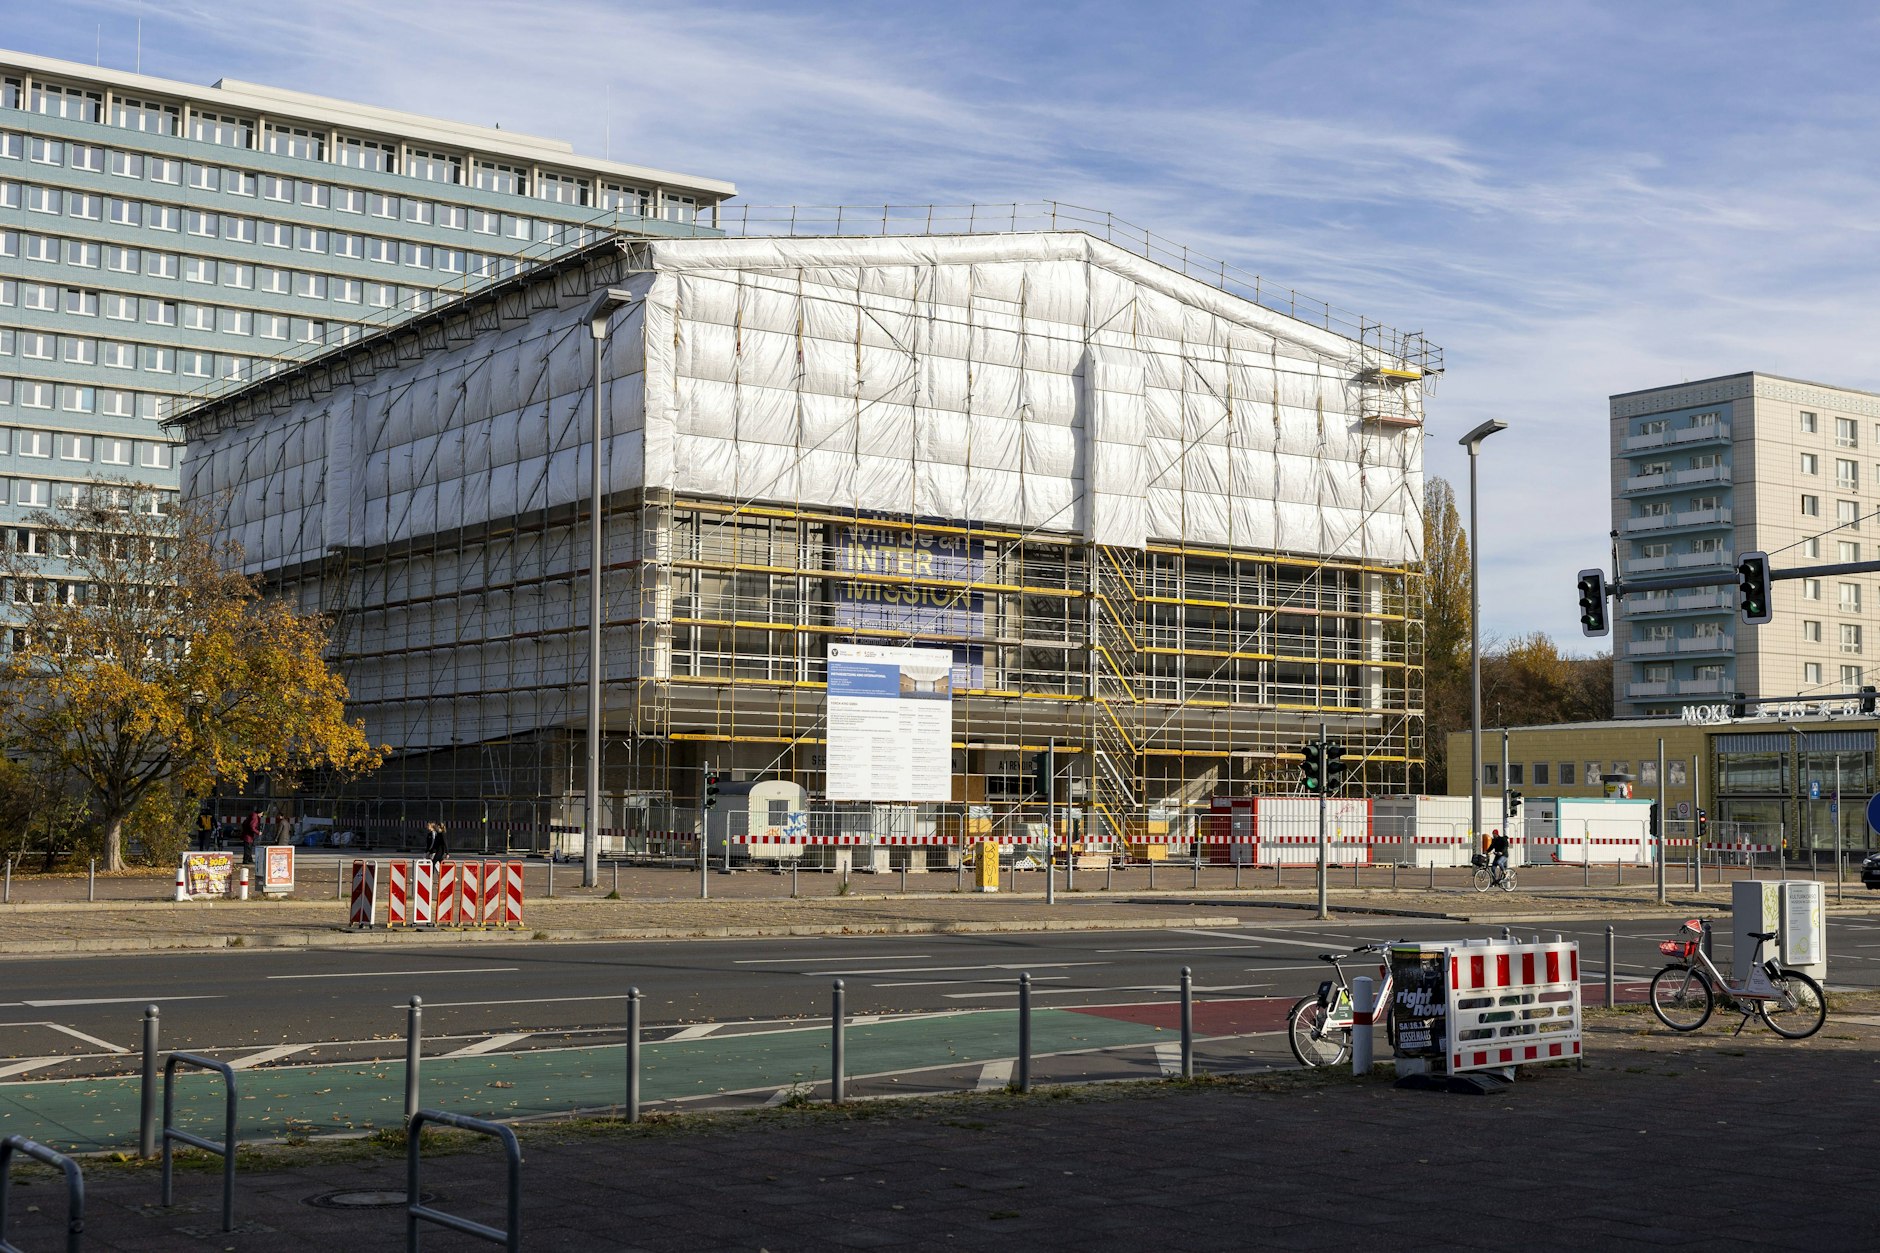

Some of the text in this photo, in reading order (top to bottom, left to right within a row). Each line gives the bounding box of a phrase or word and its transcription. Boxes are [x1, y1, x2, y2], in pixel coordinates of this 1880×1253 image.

[847, 543, 934, 576] INTER
[847, 581, 972, 608] MISSION
[1681, 704, 1737, 722] MOKK
[1396, 988, 1432, 1009] right
[1413, 1003, 1446, 1017] now
[1400, 1030, 1432, 1042] KESSELHAUS
